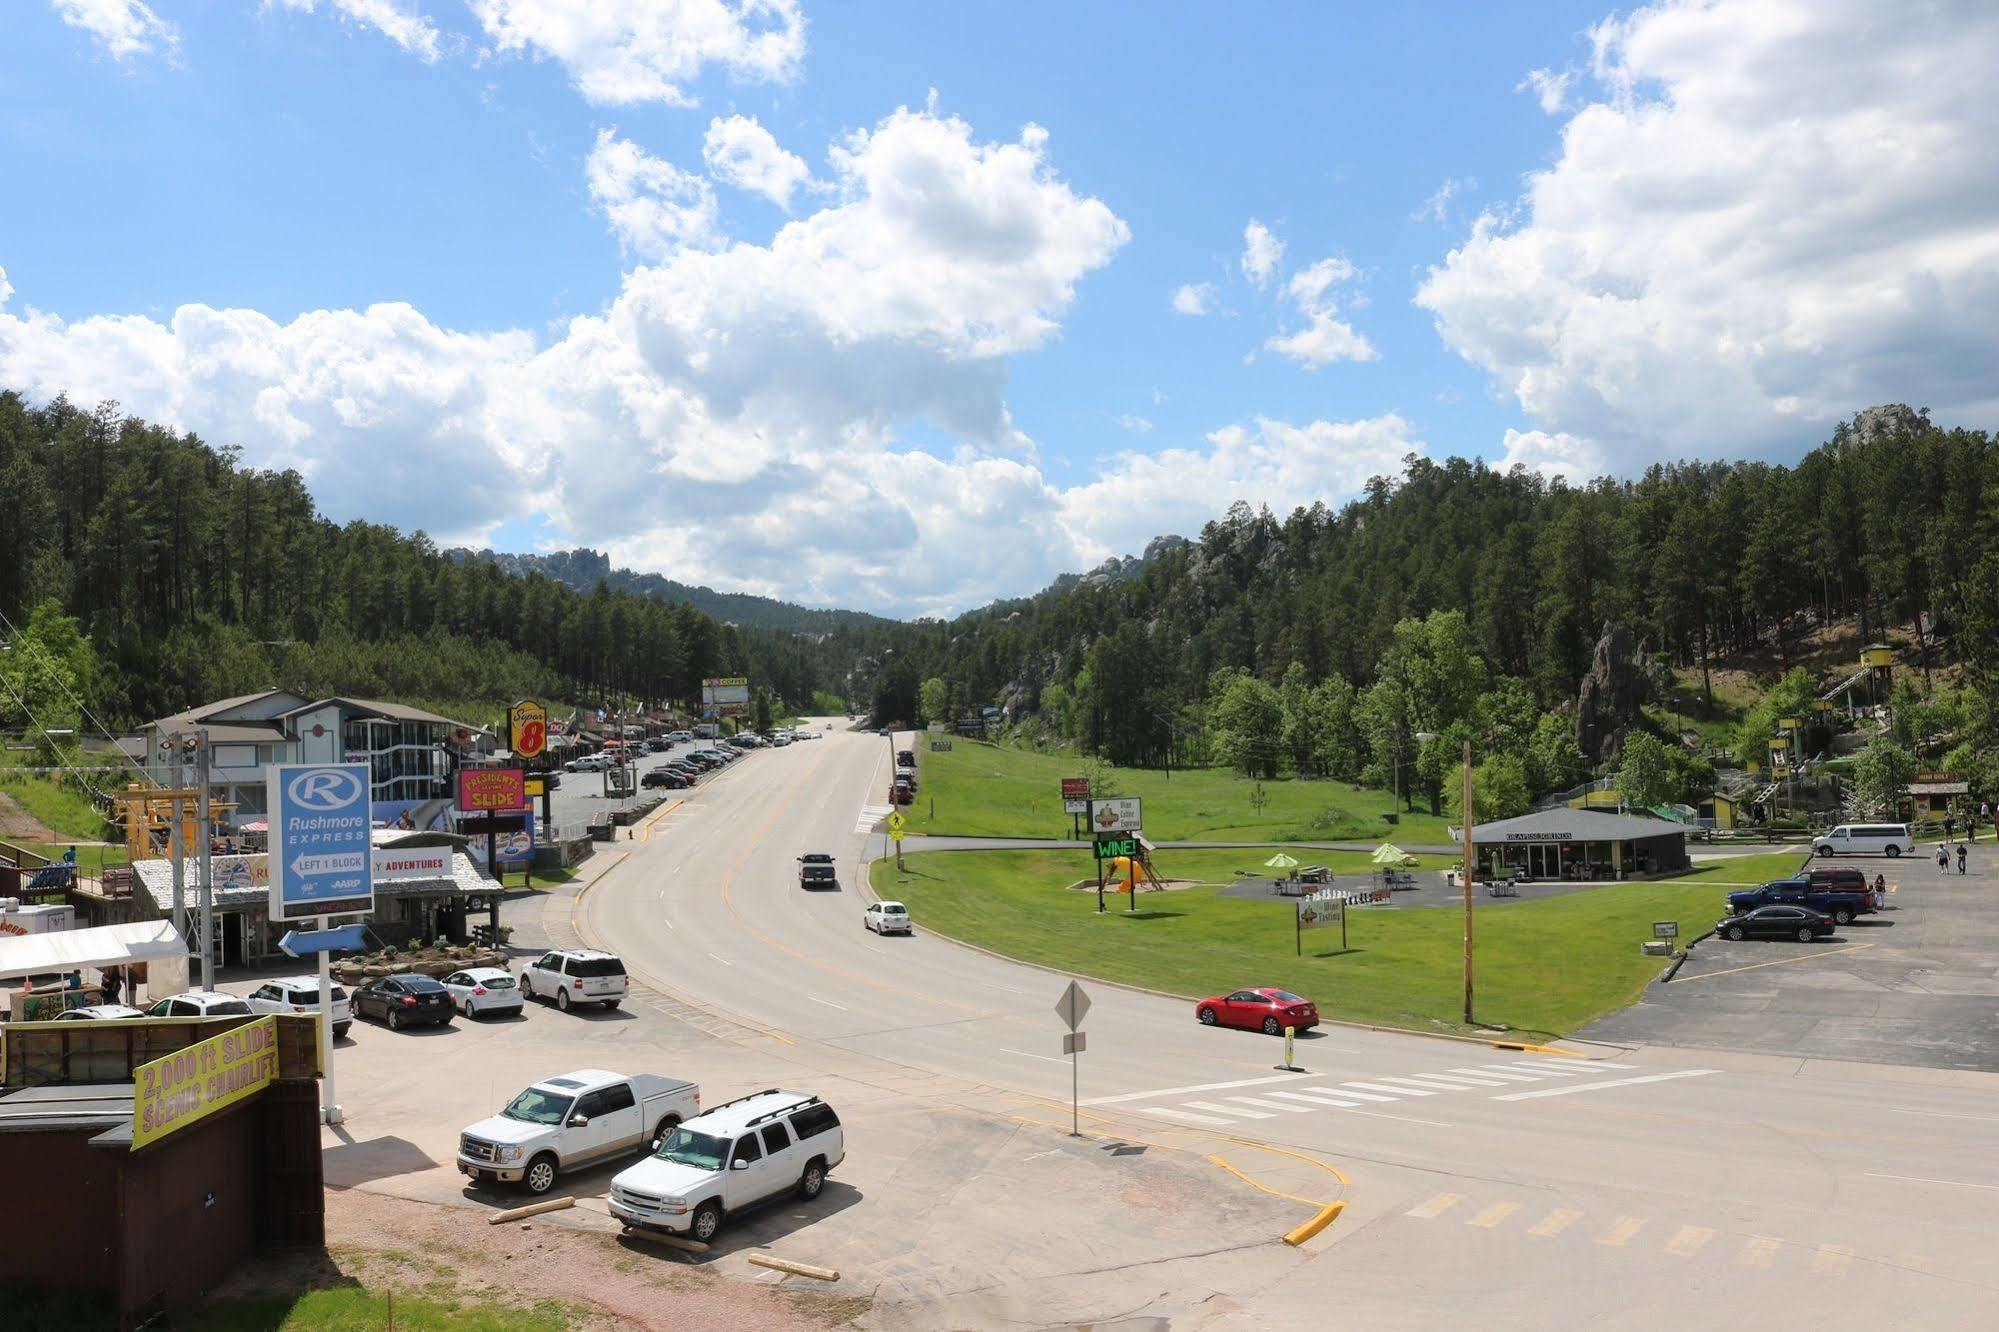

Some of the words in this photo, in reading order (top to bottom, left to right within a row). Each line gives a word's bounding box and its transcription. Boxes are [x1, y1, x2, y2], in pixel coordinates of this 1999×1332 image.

[513, 709, 543, 726] Super
[518, 721, 545, 753] 8
[303, 774, 349, 804] R
[472, 792, 515, 807] SLIDE
[289, 816, 364, 831] Rushmore
[289, 831, 364, 845] EXPRESS
[1098, 840, 1136, 857] WINE!
[300, 861, 320, 871] LEFT
[324, 860, 329, 869] 1
[333, 857, 362, 868] BLOCK
[386, 859, 443, 871] ADVENTURES
[335, 879, 361, 889] AARP
[143, 1051, 197, 1100] 2,000
[223, 1021, 275, 1064] SLIDE
[143, 1082, 201, 1133] SCENIC
[207, 1052, 276, 1103] CHAIRLIFT
